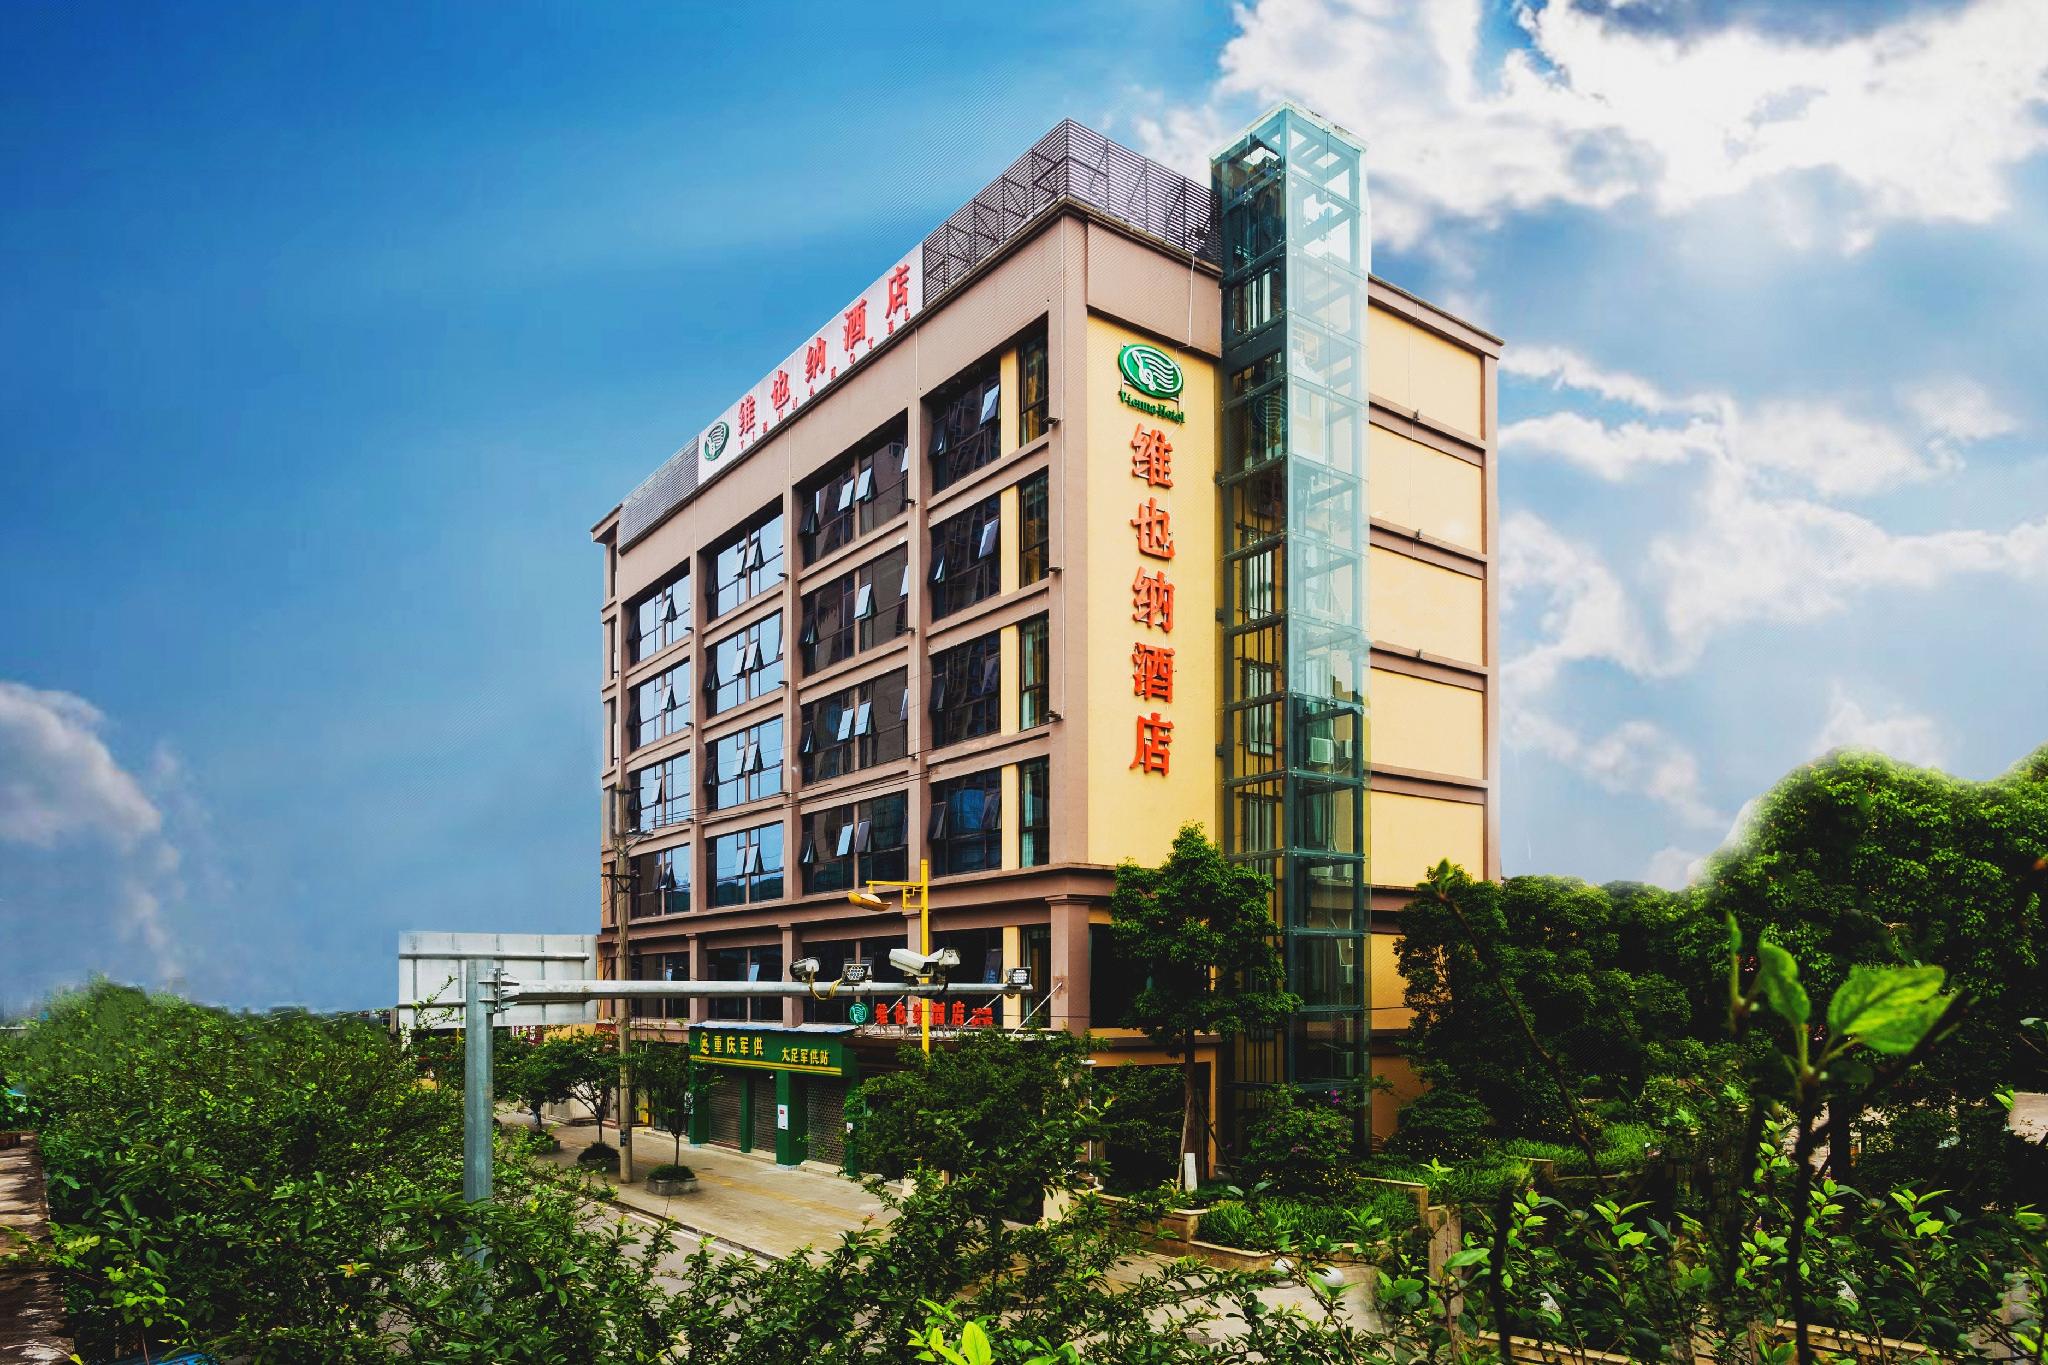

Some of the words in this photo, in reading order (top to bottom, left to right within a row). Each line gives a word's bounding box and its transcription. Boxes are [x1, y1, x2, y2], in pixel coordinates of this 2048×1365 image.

[738, 264, 911, 437] 维也纳酒店
[740, 384, 815, 449] VIENNA
[830, 308, 911, 381] HOTEL
[1129, 422, 1176, 777] 维也纳酒店
[713, 1035, 764, 1057] 重庆军供
[781, 1047, 830, 1066] 大足军供站
